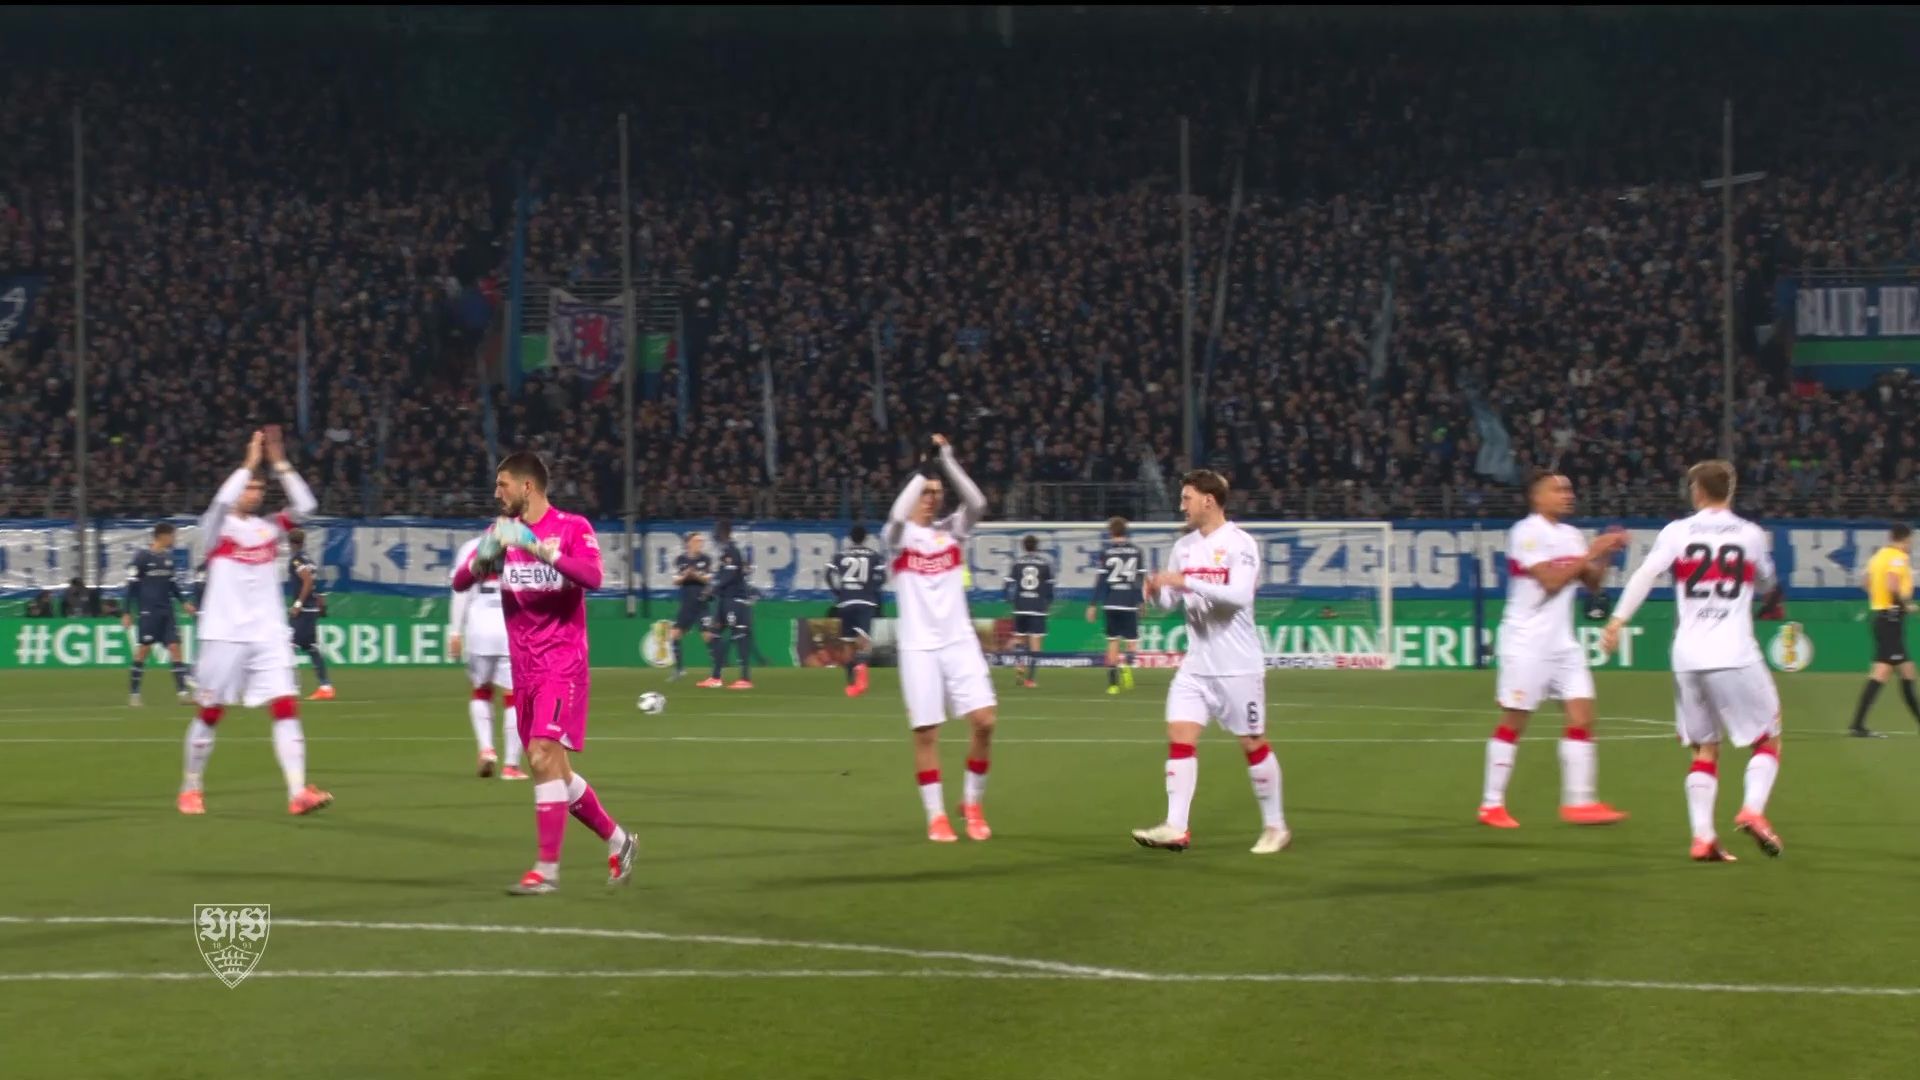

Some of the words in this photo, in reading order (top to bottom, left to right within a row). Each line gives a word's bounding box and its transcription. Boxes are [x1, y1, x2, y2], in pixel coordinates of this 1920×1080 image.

[841, 557, 869, 584] 21
[1021, 566, 1040, 590] 8
[1105, 557, 1138, 582] 24
[1685, 543, 1744, 600] 29
[1246, 701, 1259, 724] 6
